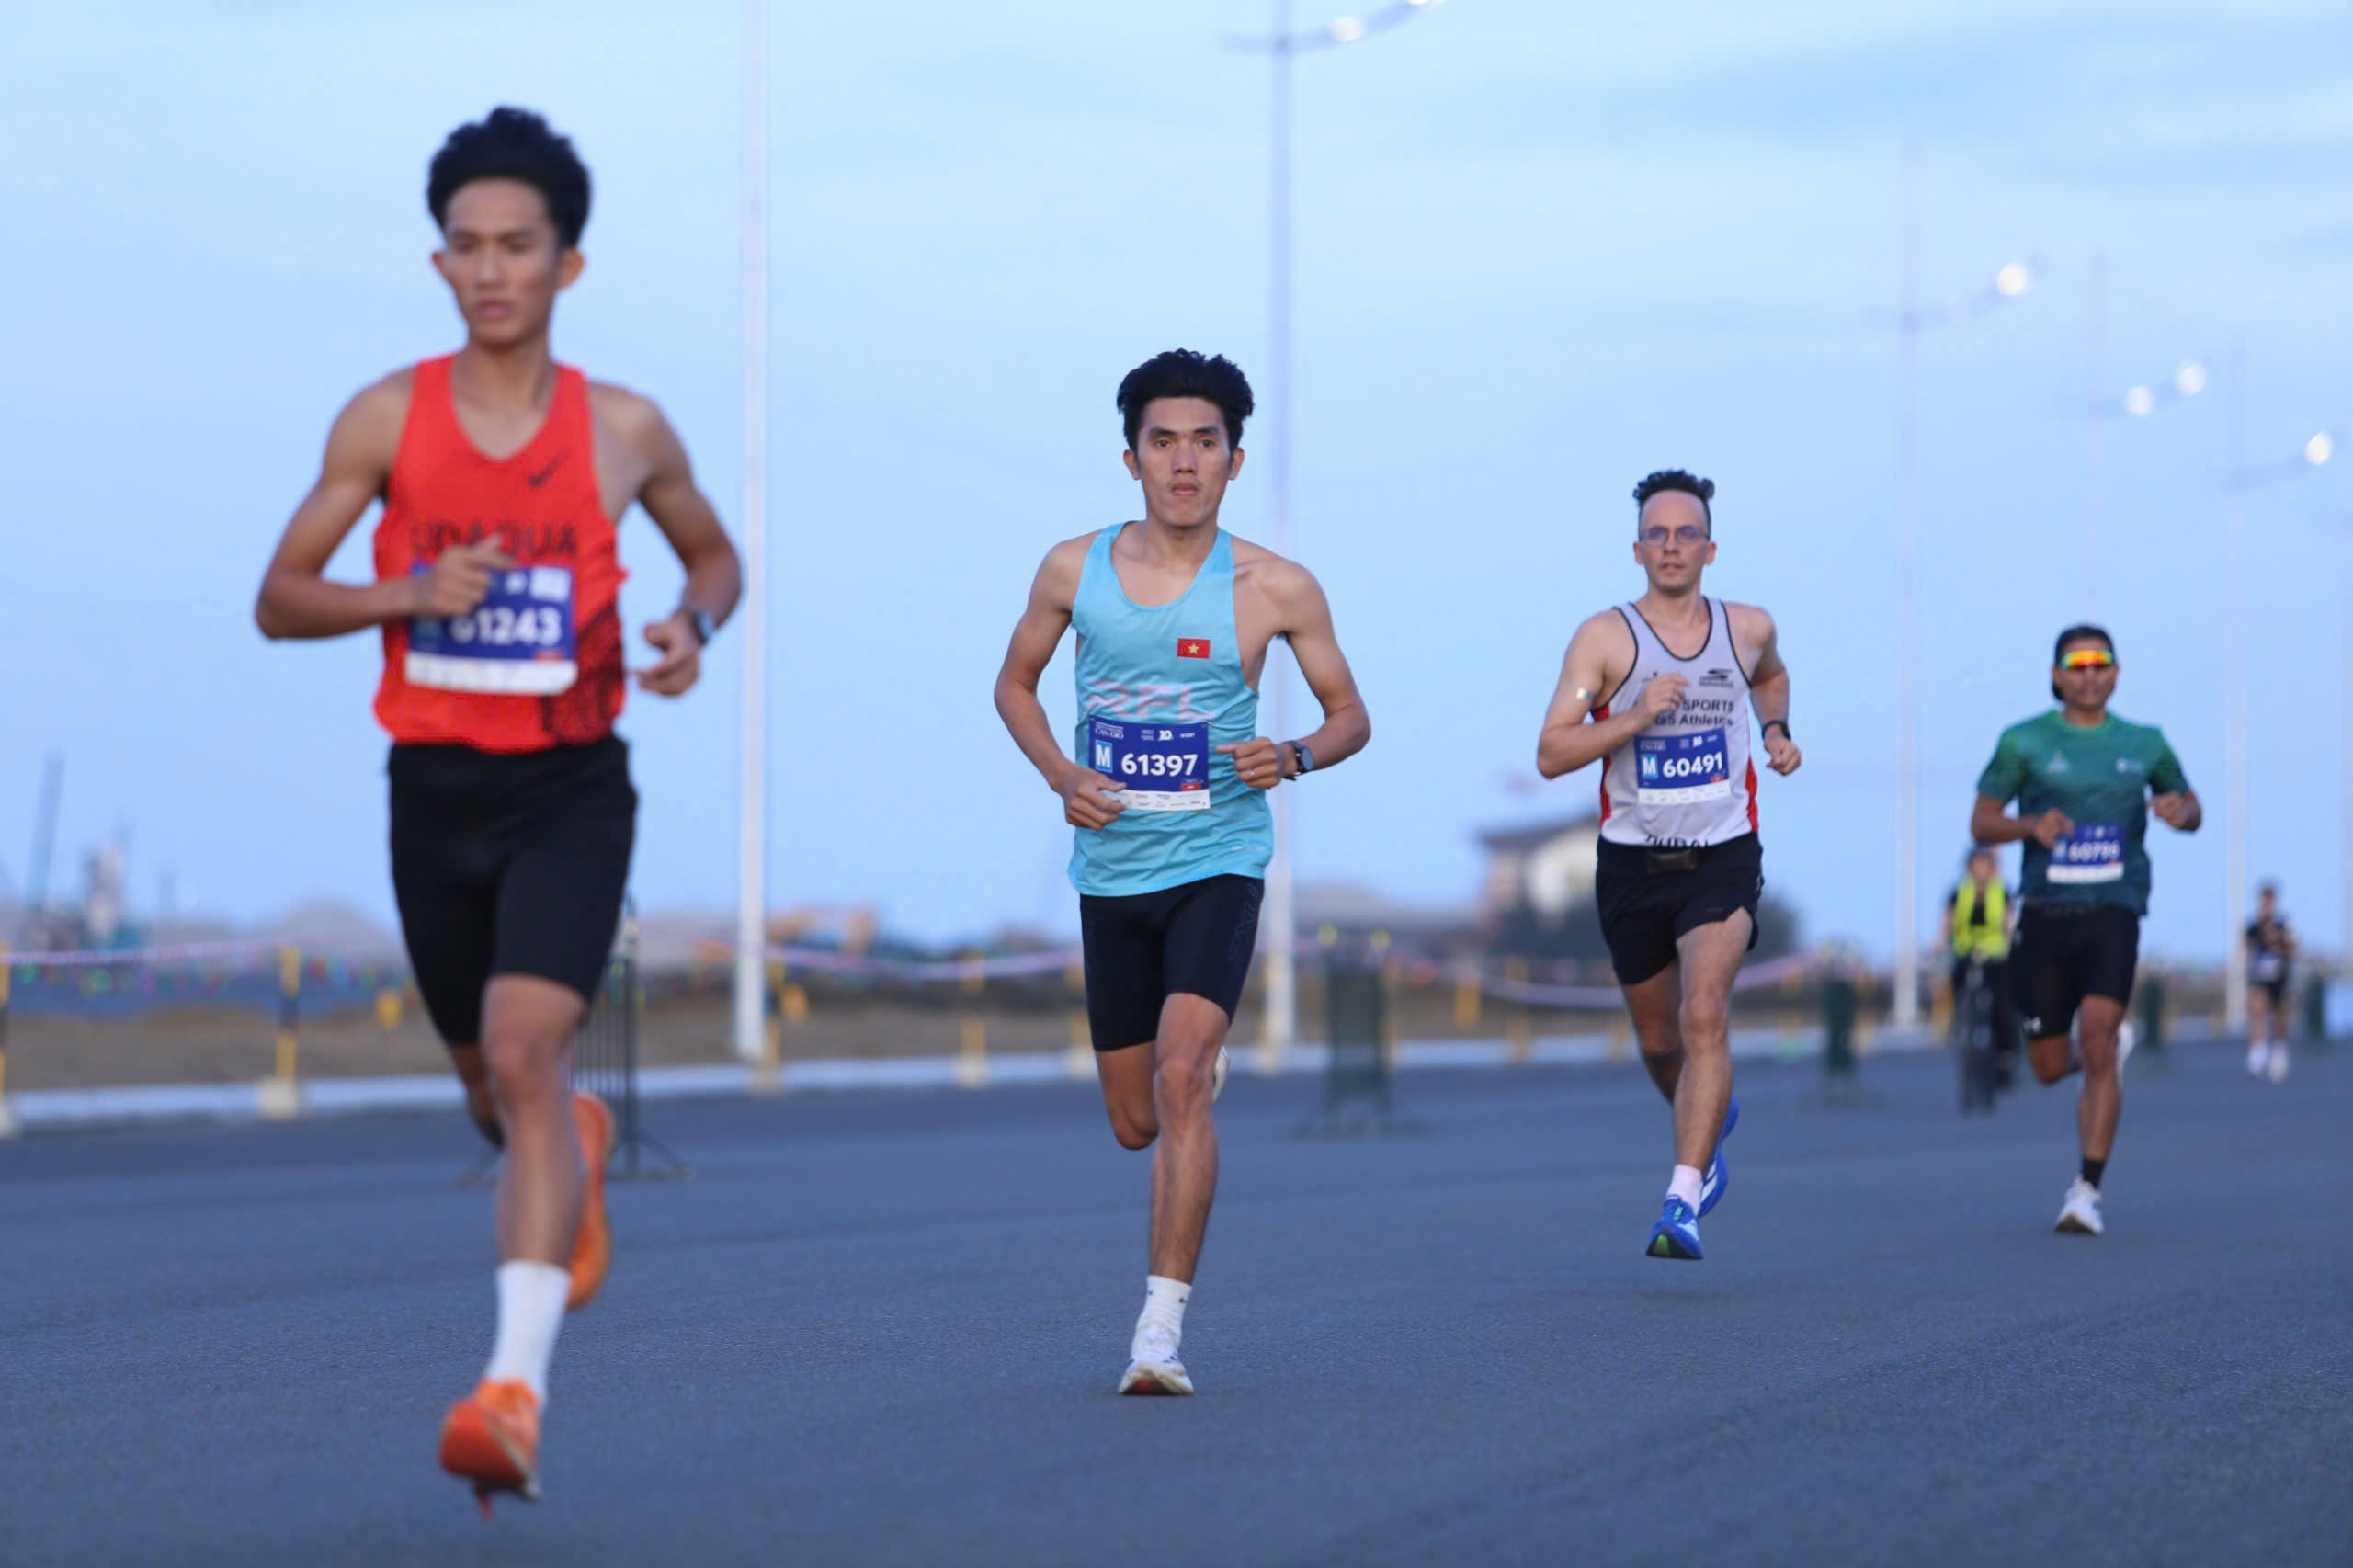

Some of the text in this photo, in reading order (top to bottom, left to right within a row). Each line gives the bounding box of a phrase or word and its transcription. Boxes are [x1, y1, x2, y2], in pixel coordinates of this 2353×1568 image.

[1096, 744, 1198, 777] M 61397
[1642, 751, 1722, 778] M 60491
